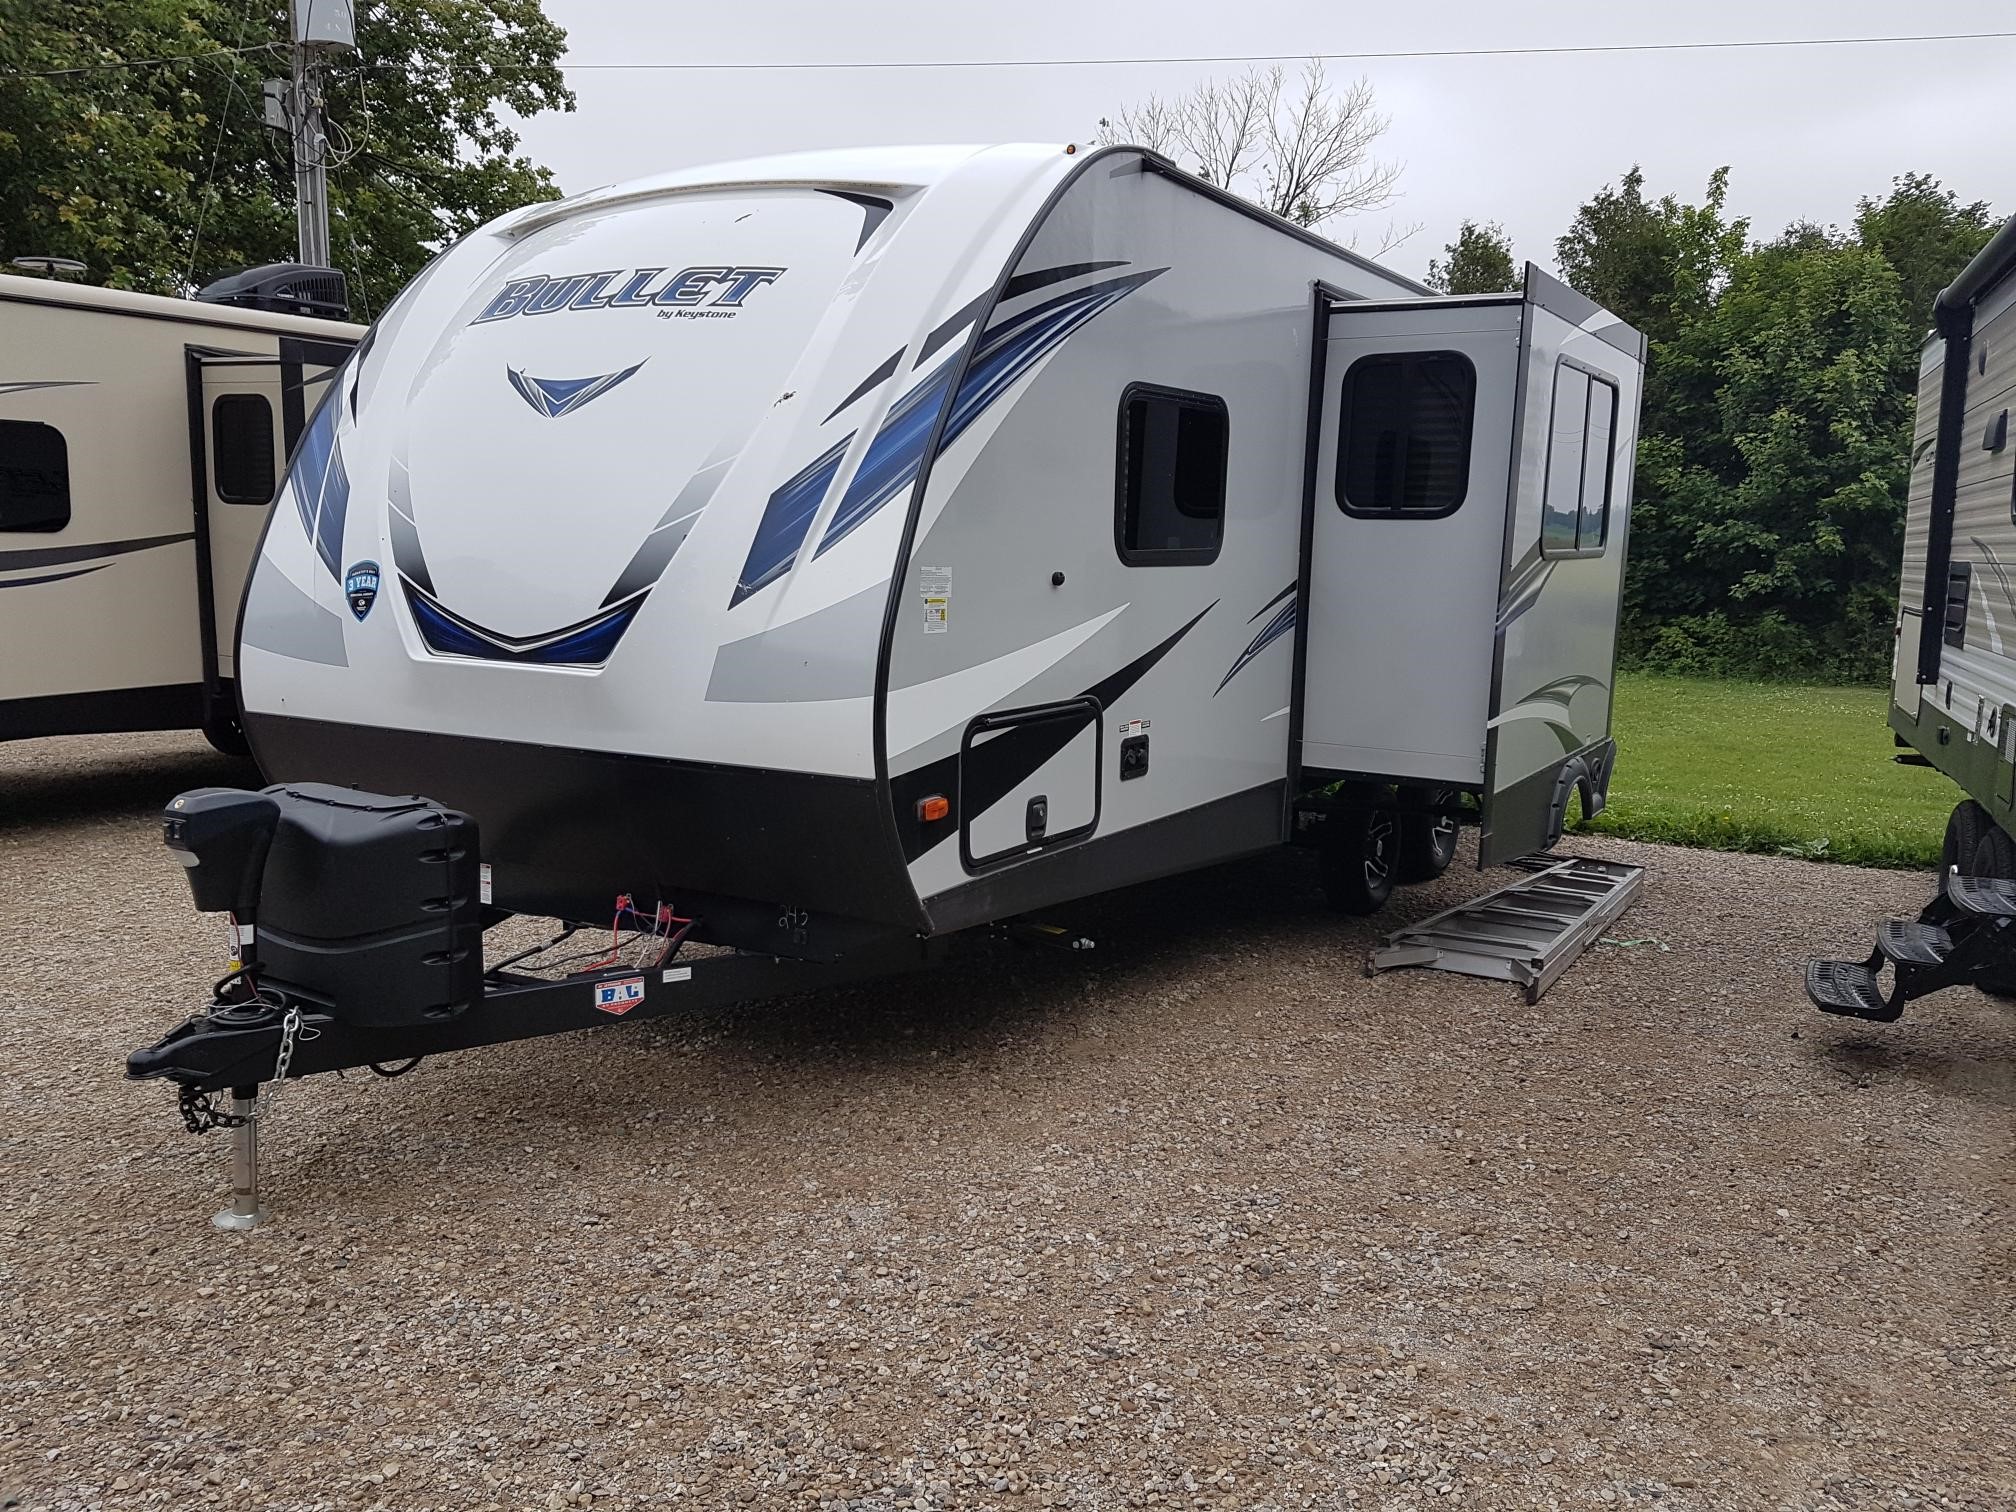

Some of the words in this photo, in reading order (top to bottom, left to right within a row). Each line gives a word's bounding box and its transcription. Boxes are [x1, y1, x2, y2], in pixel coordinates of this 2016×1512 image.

[466, 266, 788, 327] BULLET
[656, 309, 674, 320] by
[675, 309, 737, 320] Keystone
[348, 580, 354, 591] 3
[355, 575, 377, 590] YEAR
